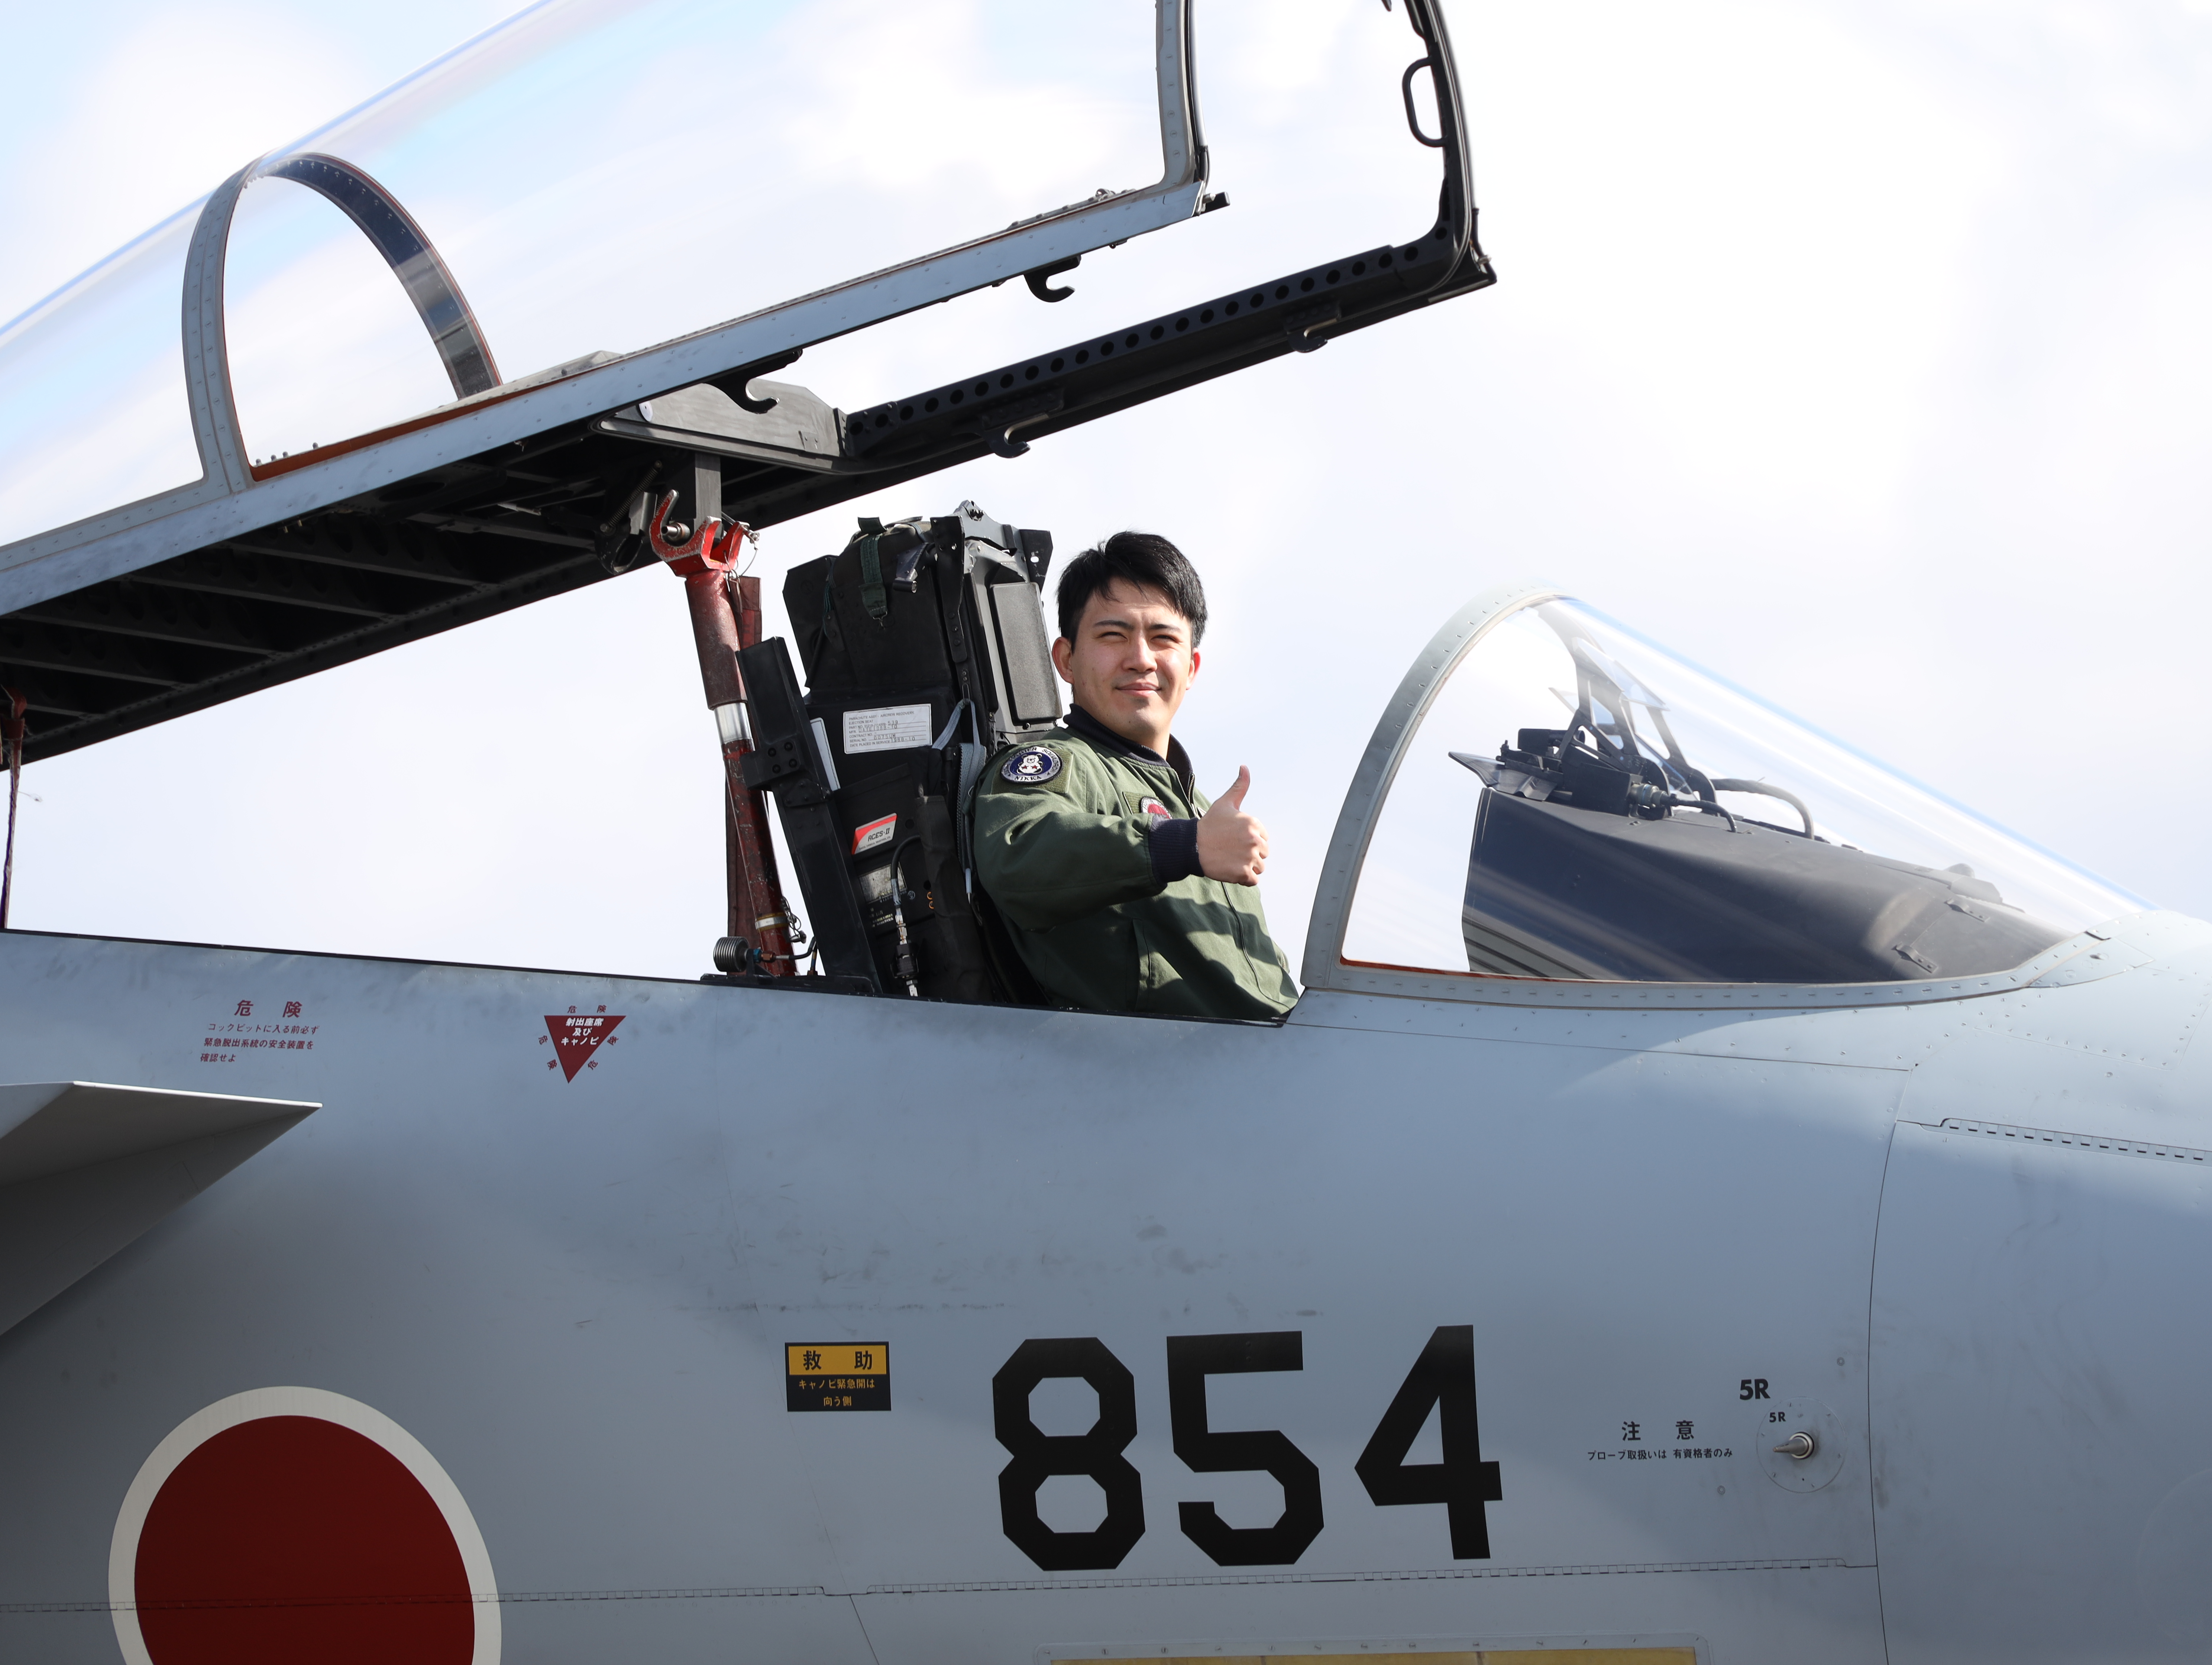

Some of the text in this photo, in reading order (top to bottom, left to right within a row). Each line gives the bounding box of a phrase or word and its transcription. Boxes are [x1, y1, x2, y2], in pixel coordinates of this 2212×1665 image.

[234, 1000, 302, 1018] 危険
[567, 1005, 607, 1013] 危険
[566, 1018, 604, 1027] 射出座席
[208, 1023, 320, 1035] コックピットに入る前必ず
[572, 1027, 592, 1036] 及び
[204, 1038, 314, 1050] 緊急脱出系統の安全装置を
[561, 1037, 599, 1046] キャノピ
[200, 1053, 236, 1063] 確認せよ
[803, 1350, 872, 1370] 救助
[799, 1378, 875, 1390] キャノピ緊急開は
[1740, 1378, 1770, 1400] 5R
[824, 1396, 852, 1406] 向う側
[1769, 1412, 1786, 1423] 5R
[1621, 1420, 1694, 1441] 注意
[992, 1325, 1503, 1571] 854
[1588, 1448, 1733, 1461] プローブ取扱いは 有資格者のみ
